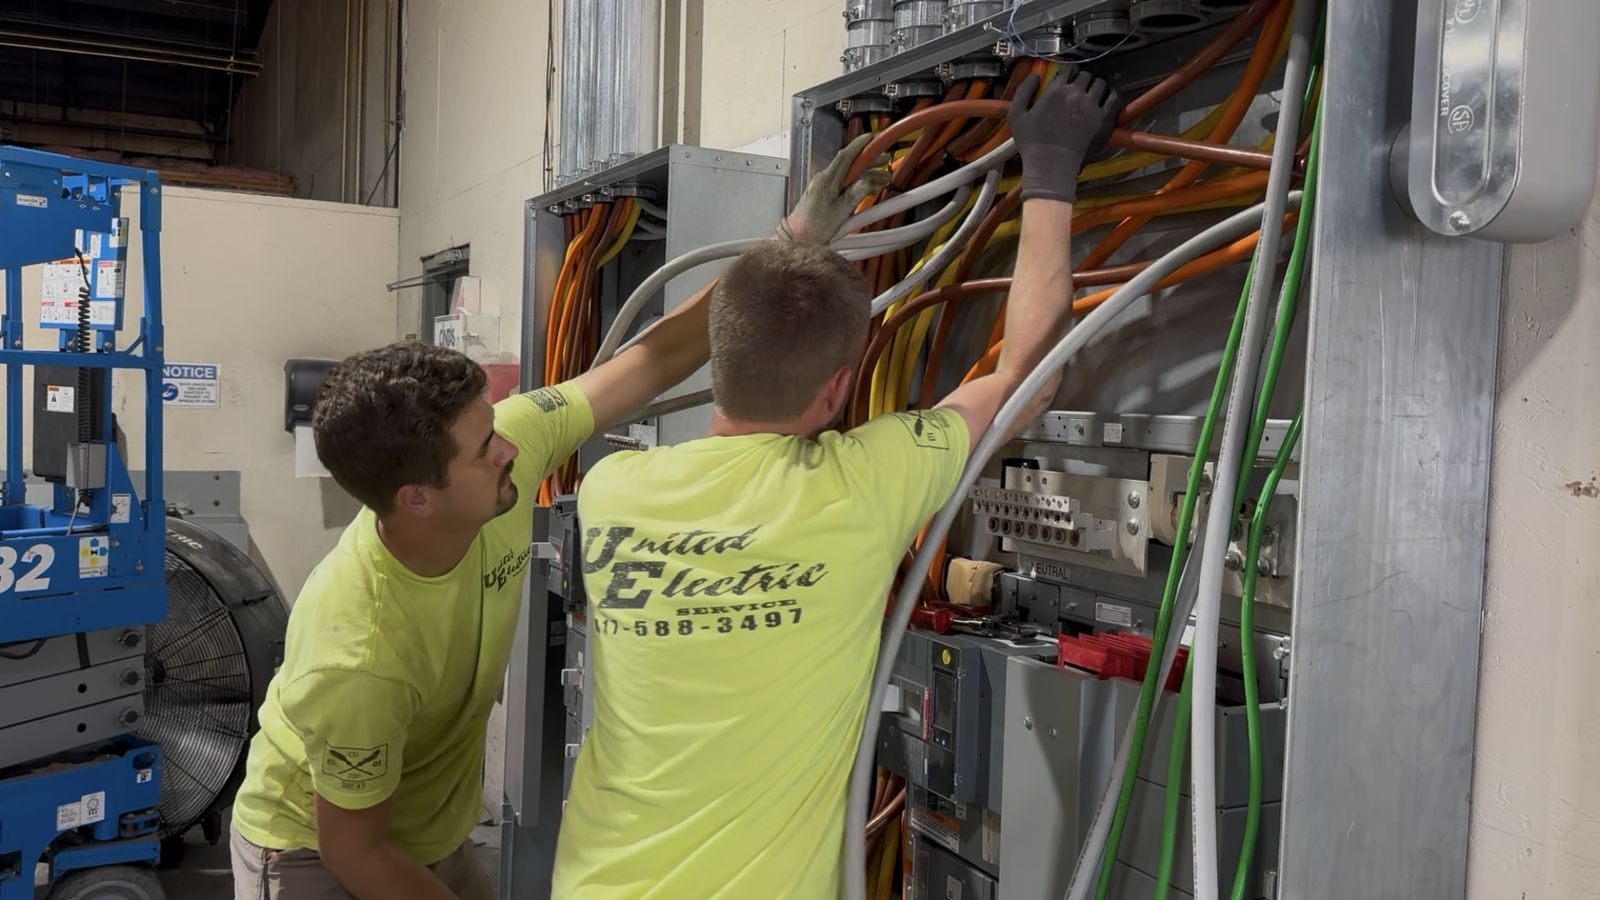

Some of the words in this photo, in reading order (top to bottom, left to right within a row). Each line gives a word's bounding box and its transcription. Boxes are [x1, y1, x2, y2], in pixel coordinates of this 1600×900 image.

[162, 366, 215, 378] NOTICE
[584, 525, 762, 574] United
[599, 561, 829, 609] Electric
[675, 598, 798, 616] SERVICE
